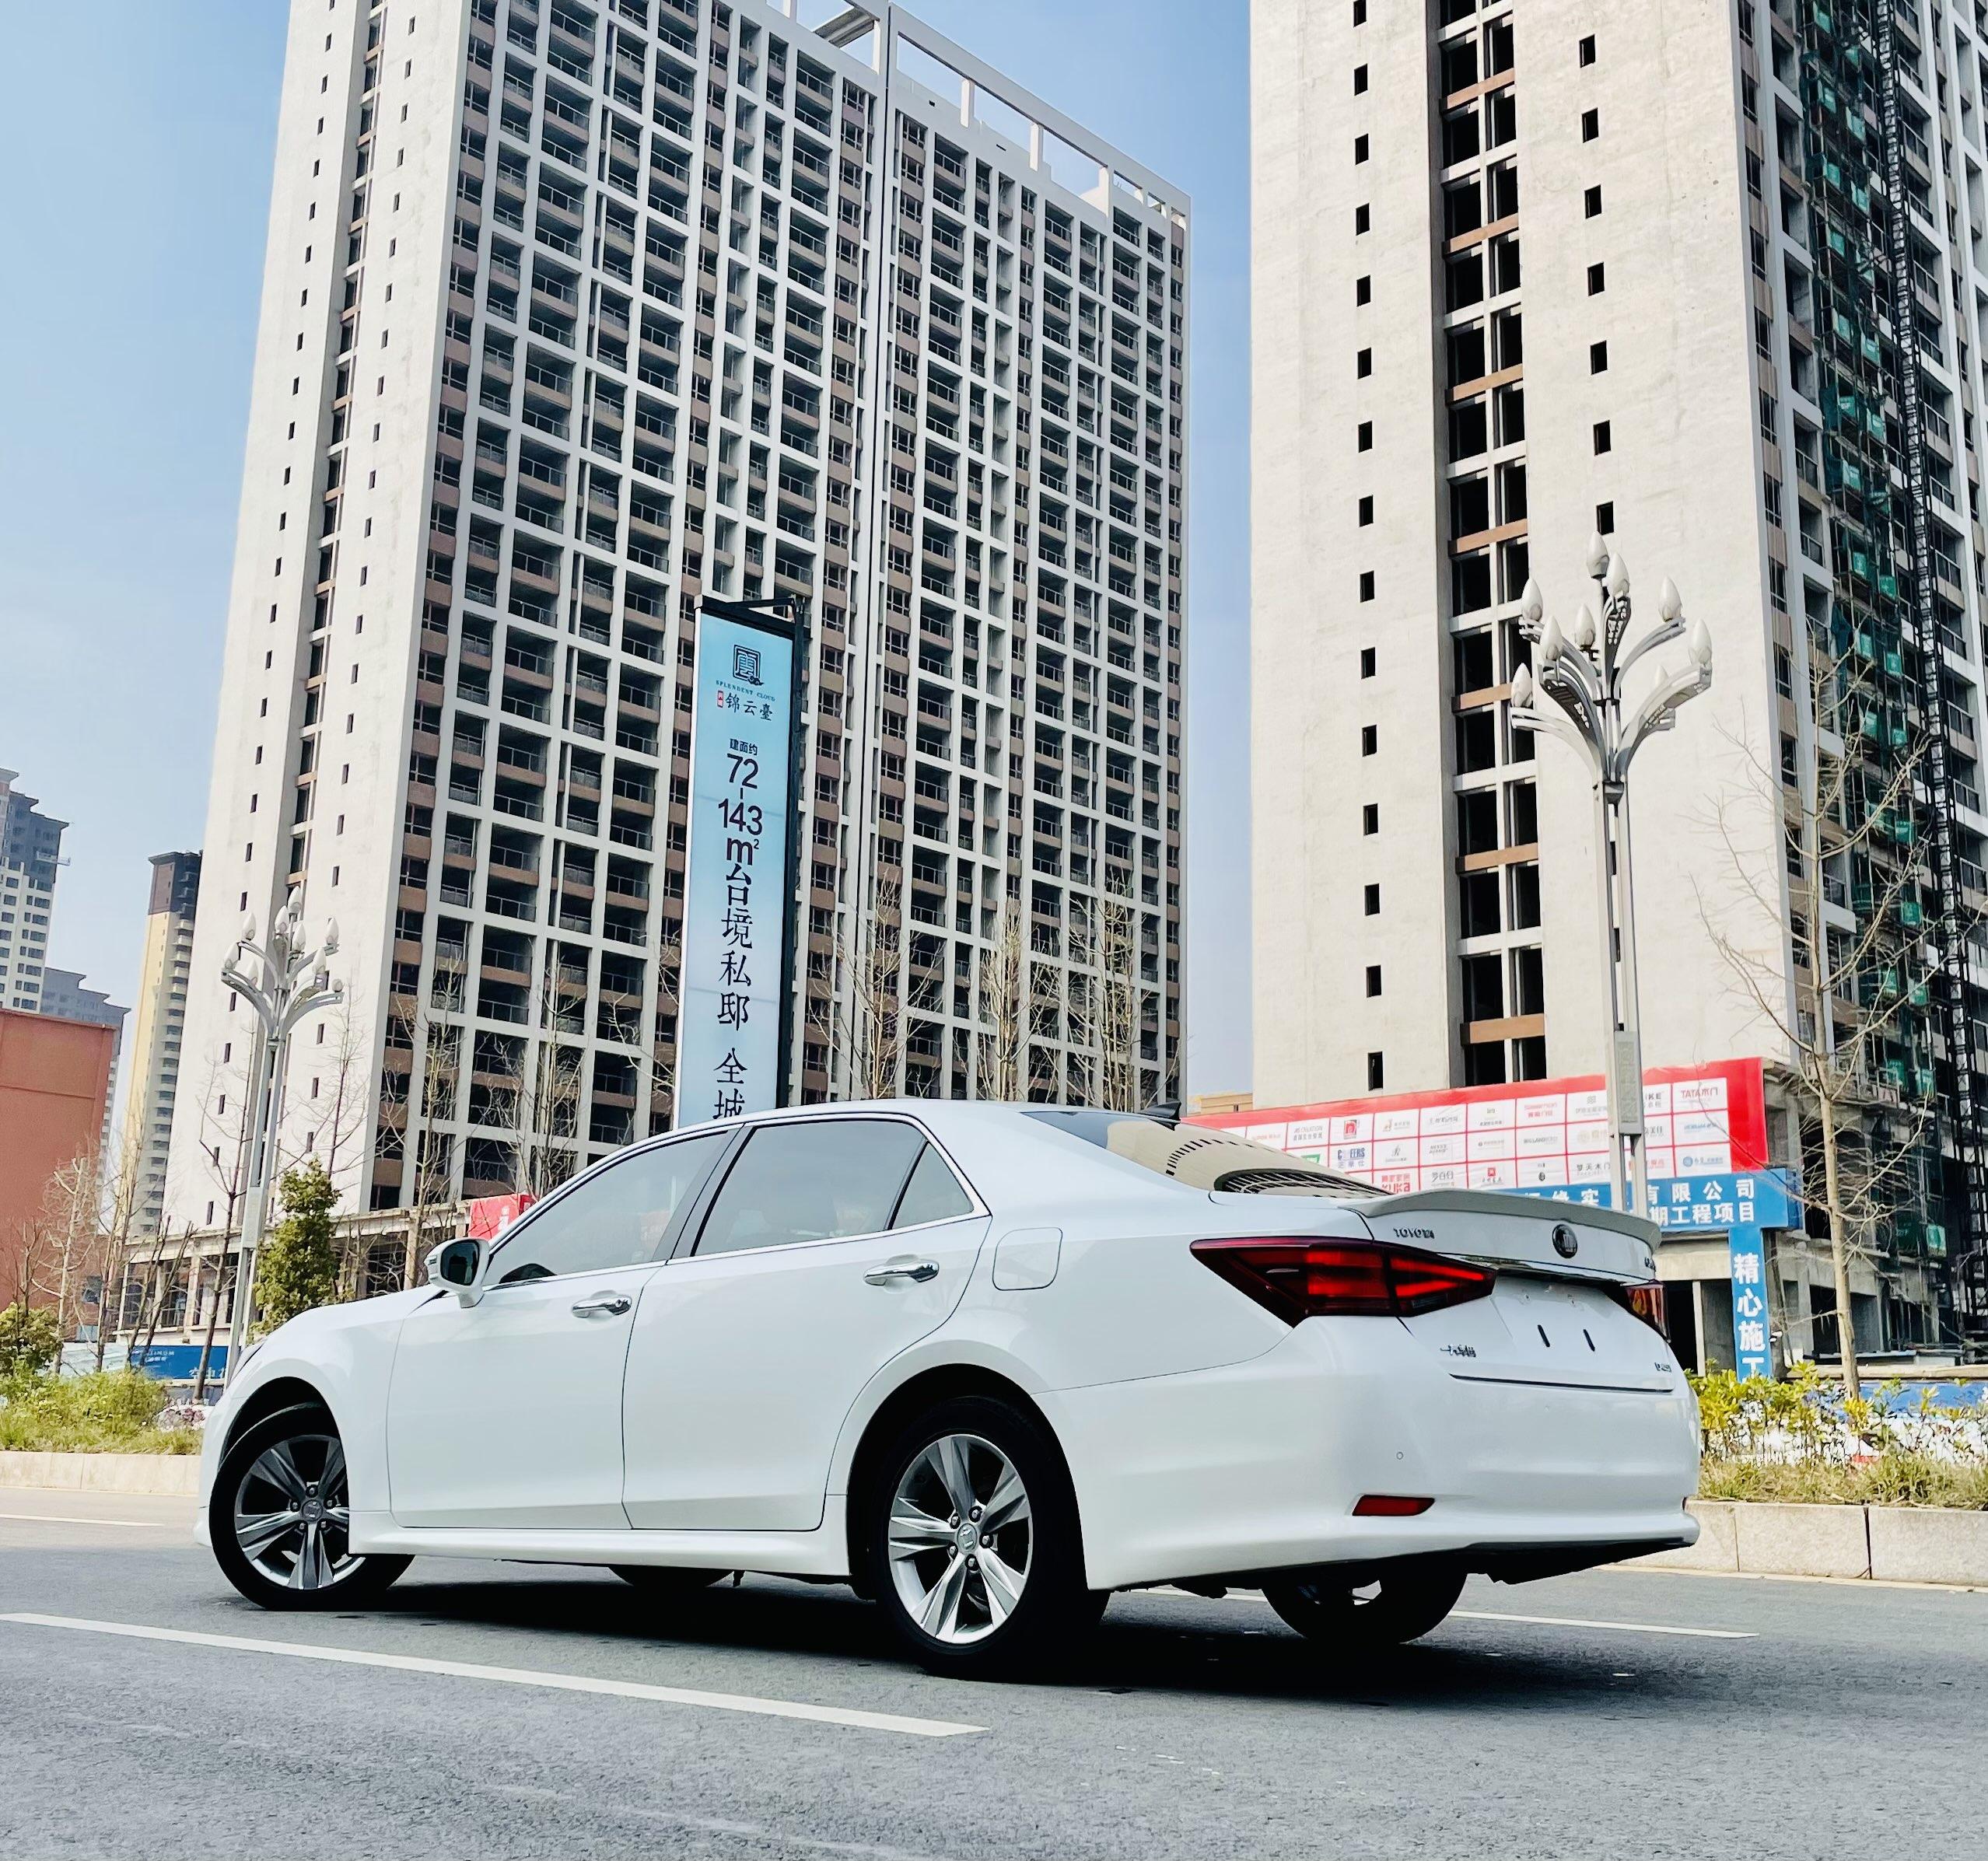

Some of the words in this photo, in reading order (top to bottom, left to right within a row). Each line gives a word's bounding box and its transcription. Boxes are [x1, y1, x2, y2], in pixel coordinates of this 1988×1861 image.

[716, 680, 754, 695] SPLENDENT
[730, 738, 758, 756] 建面约
[726, 753, 759, 789] 72
[718, 798, 763, 836] 143
[717, 862, 754, 1031] 台境私邸
